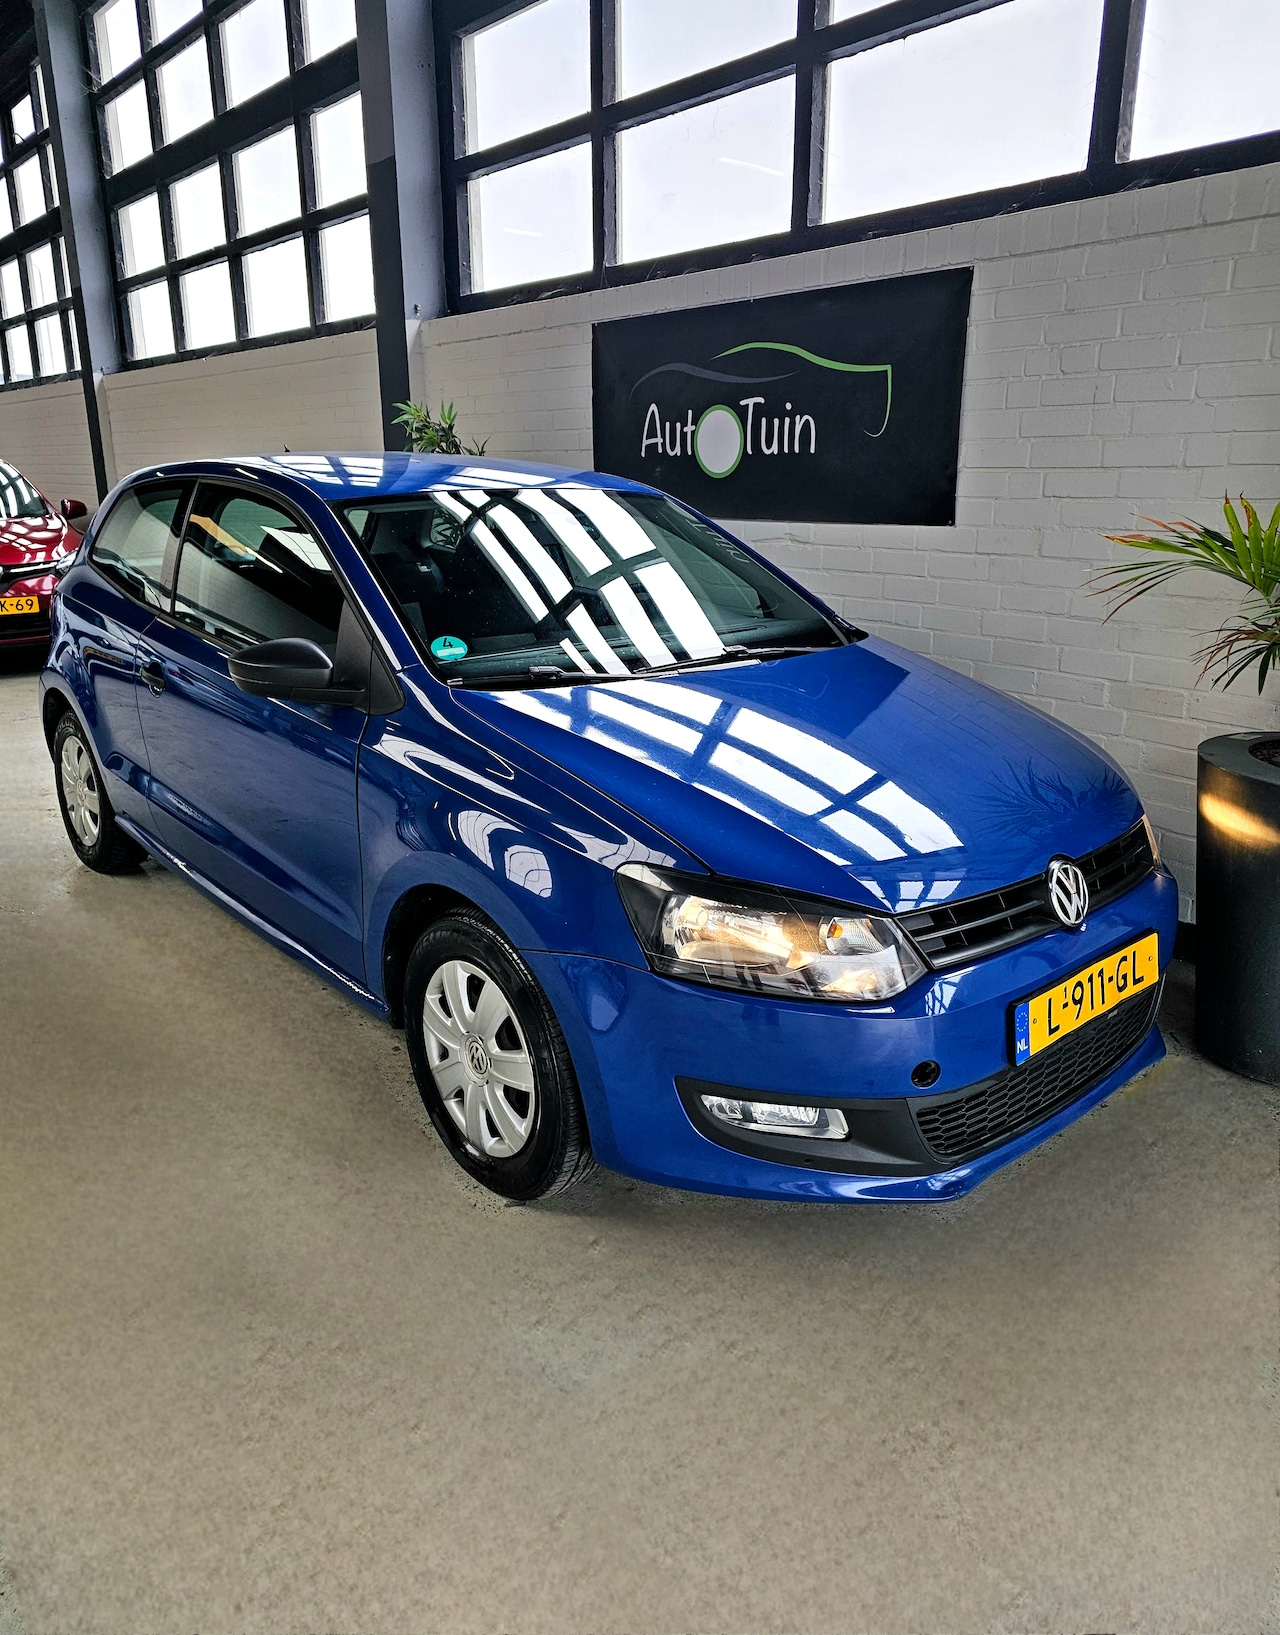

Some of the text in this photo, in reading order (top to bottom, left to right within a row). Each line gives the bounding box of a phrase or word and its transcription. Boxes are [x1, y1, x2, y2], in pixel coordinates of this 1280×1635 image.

[442, 637, 454, 648] 4
[1047, 949, 1145, 1037] L-911-GL
[1016, 1037, 1029, 1054] NL
